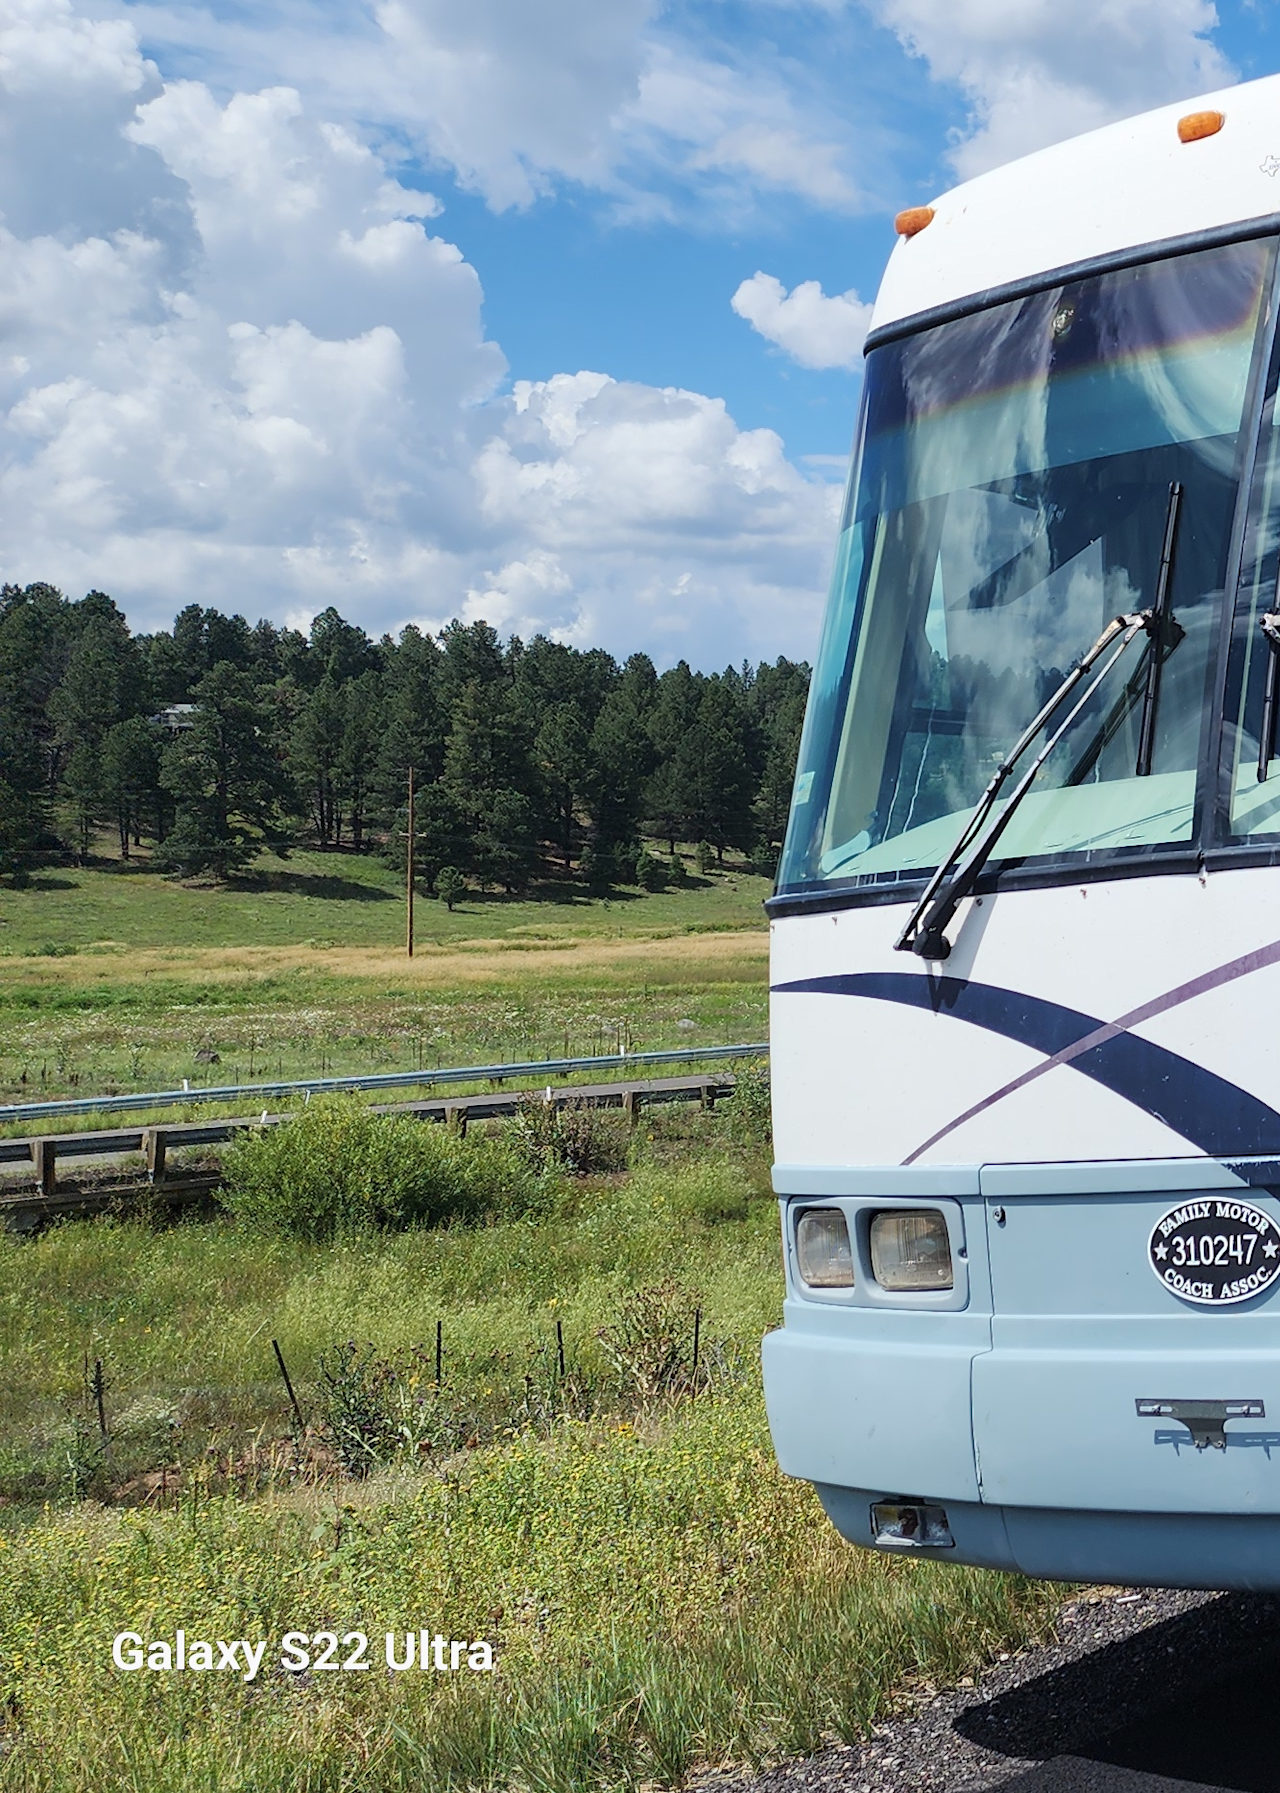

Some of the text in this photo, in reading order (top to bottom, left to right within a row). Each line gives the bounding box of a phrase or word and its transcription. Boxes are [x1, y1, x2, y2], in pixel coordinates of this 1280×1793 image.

[1158, 1202, 1270, 1238] FAMILY MOTOR
[1171, 1233, 1258, 1267] 310247
[1163, 1267, 1213, 1298] COACH
